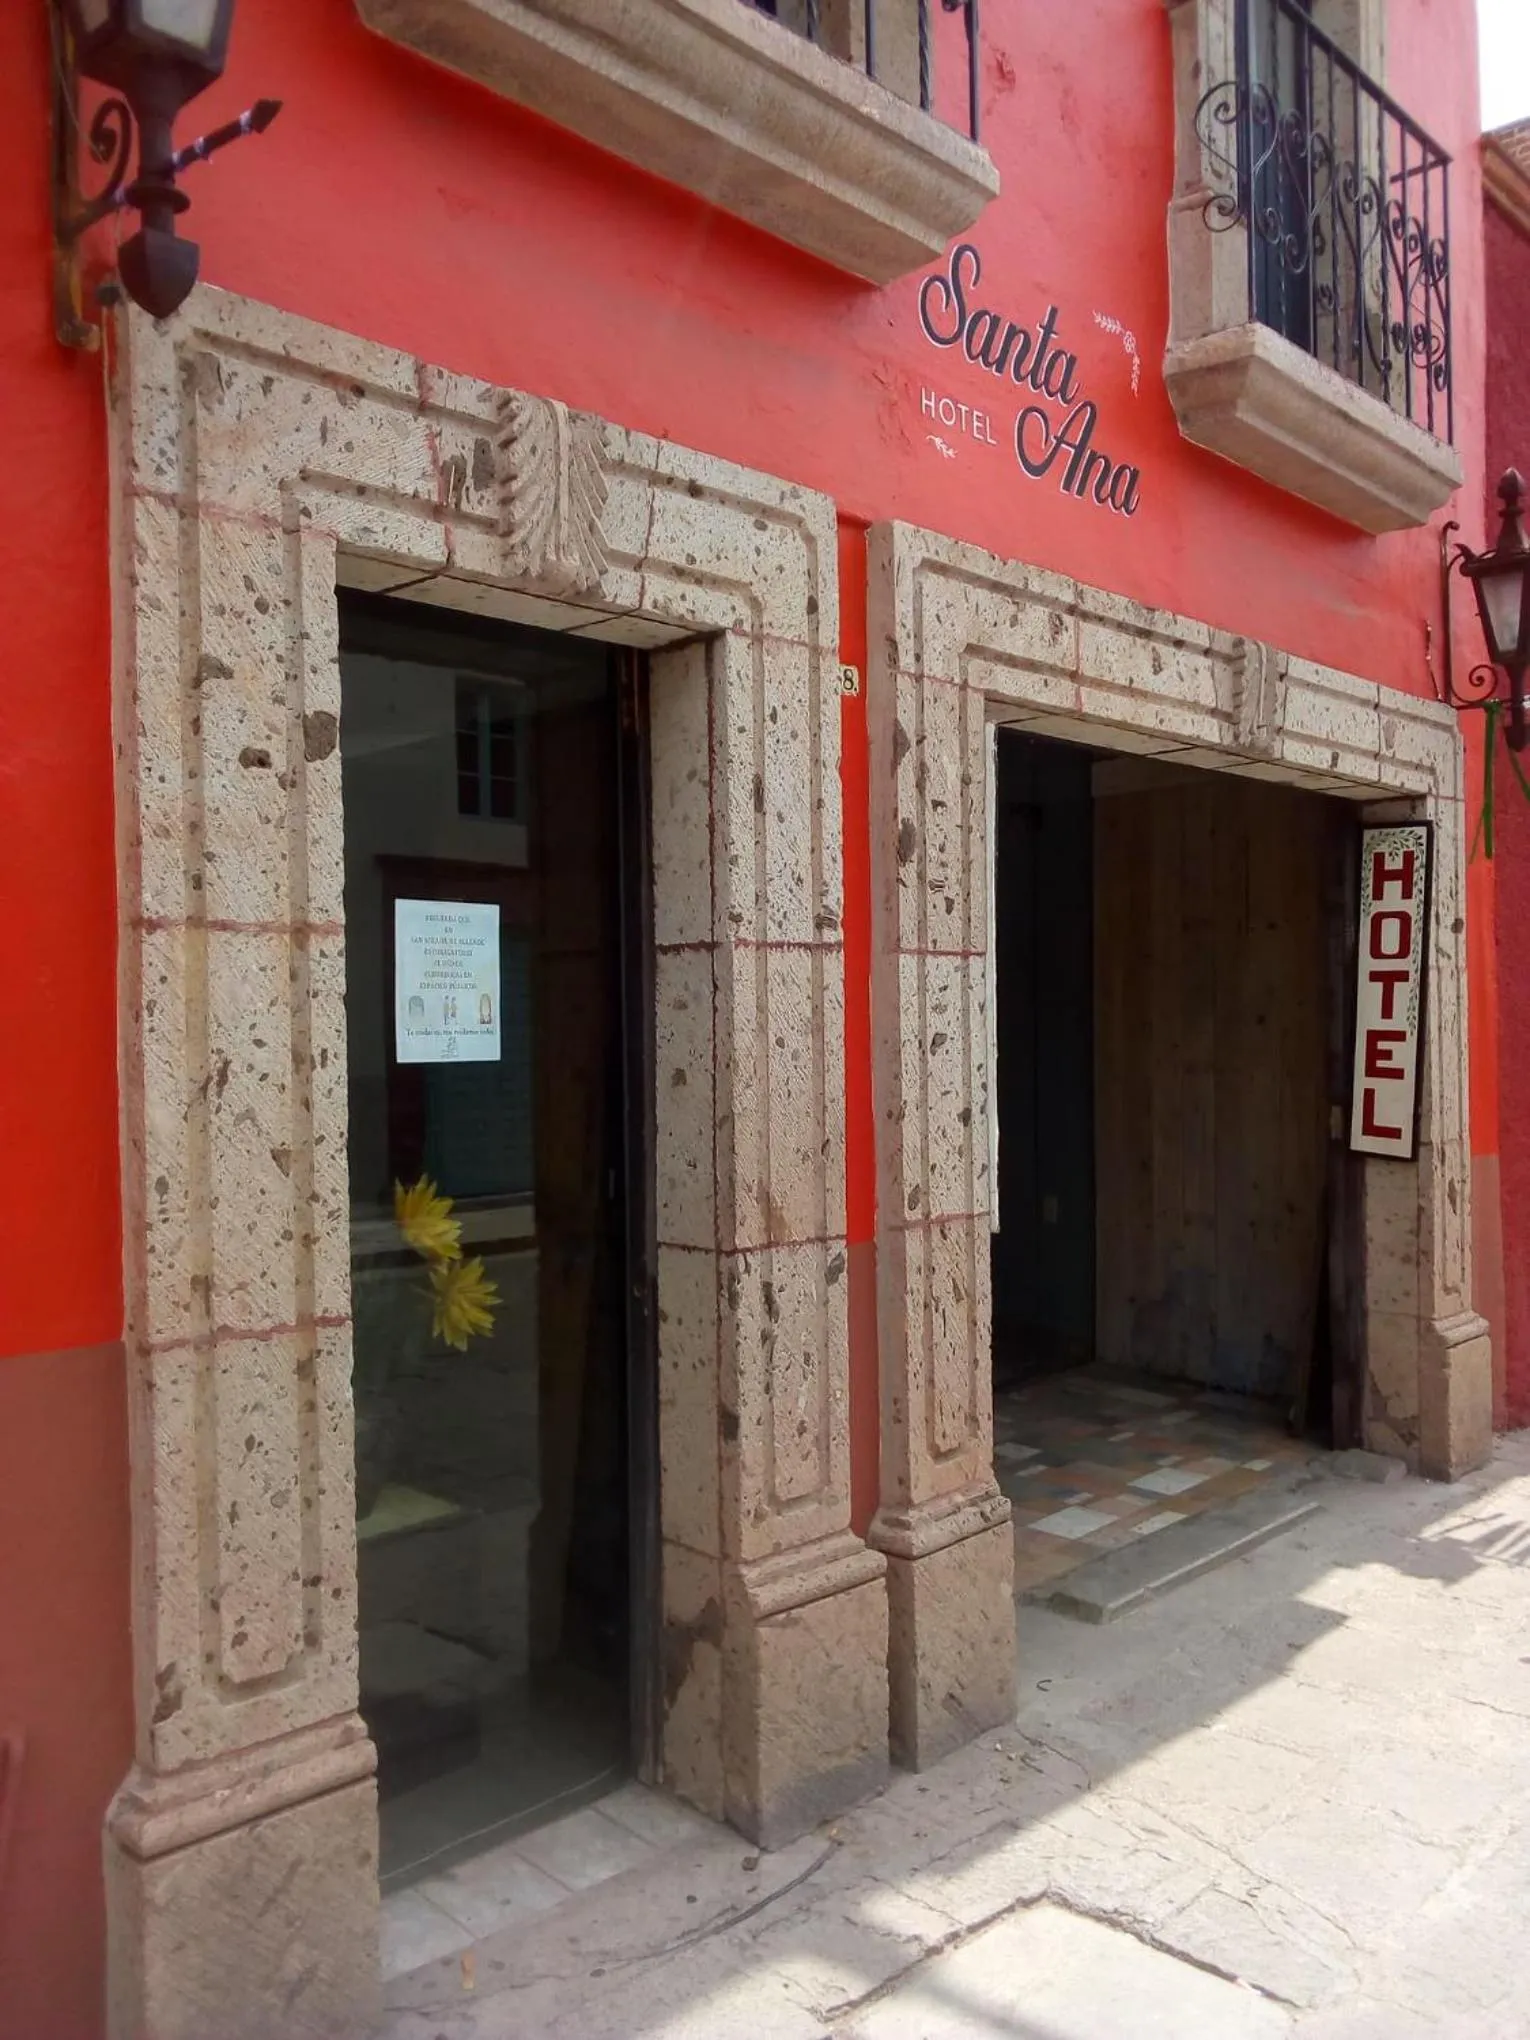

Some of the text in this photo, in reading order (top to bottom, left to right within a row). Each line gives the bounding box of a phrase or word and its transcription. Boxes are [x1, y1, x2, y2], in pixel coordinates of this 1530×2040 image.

[918, 244, 1080, 407] Santa
[921, 387, 998, 445] HOTEL
[1014, 400, 1140, 518] Ana
[1362, 850, 1415, 1140] HOTEL
